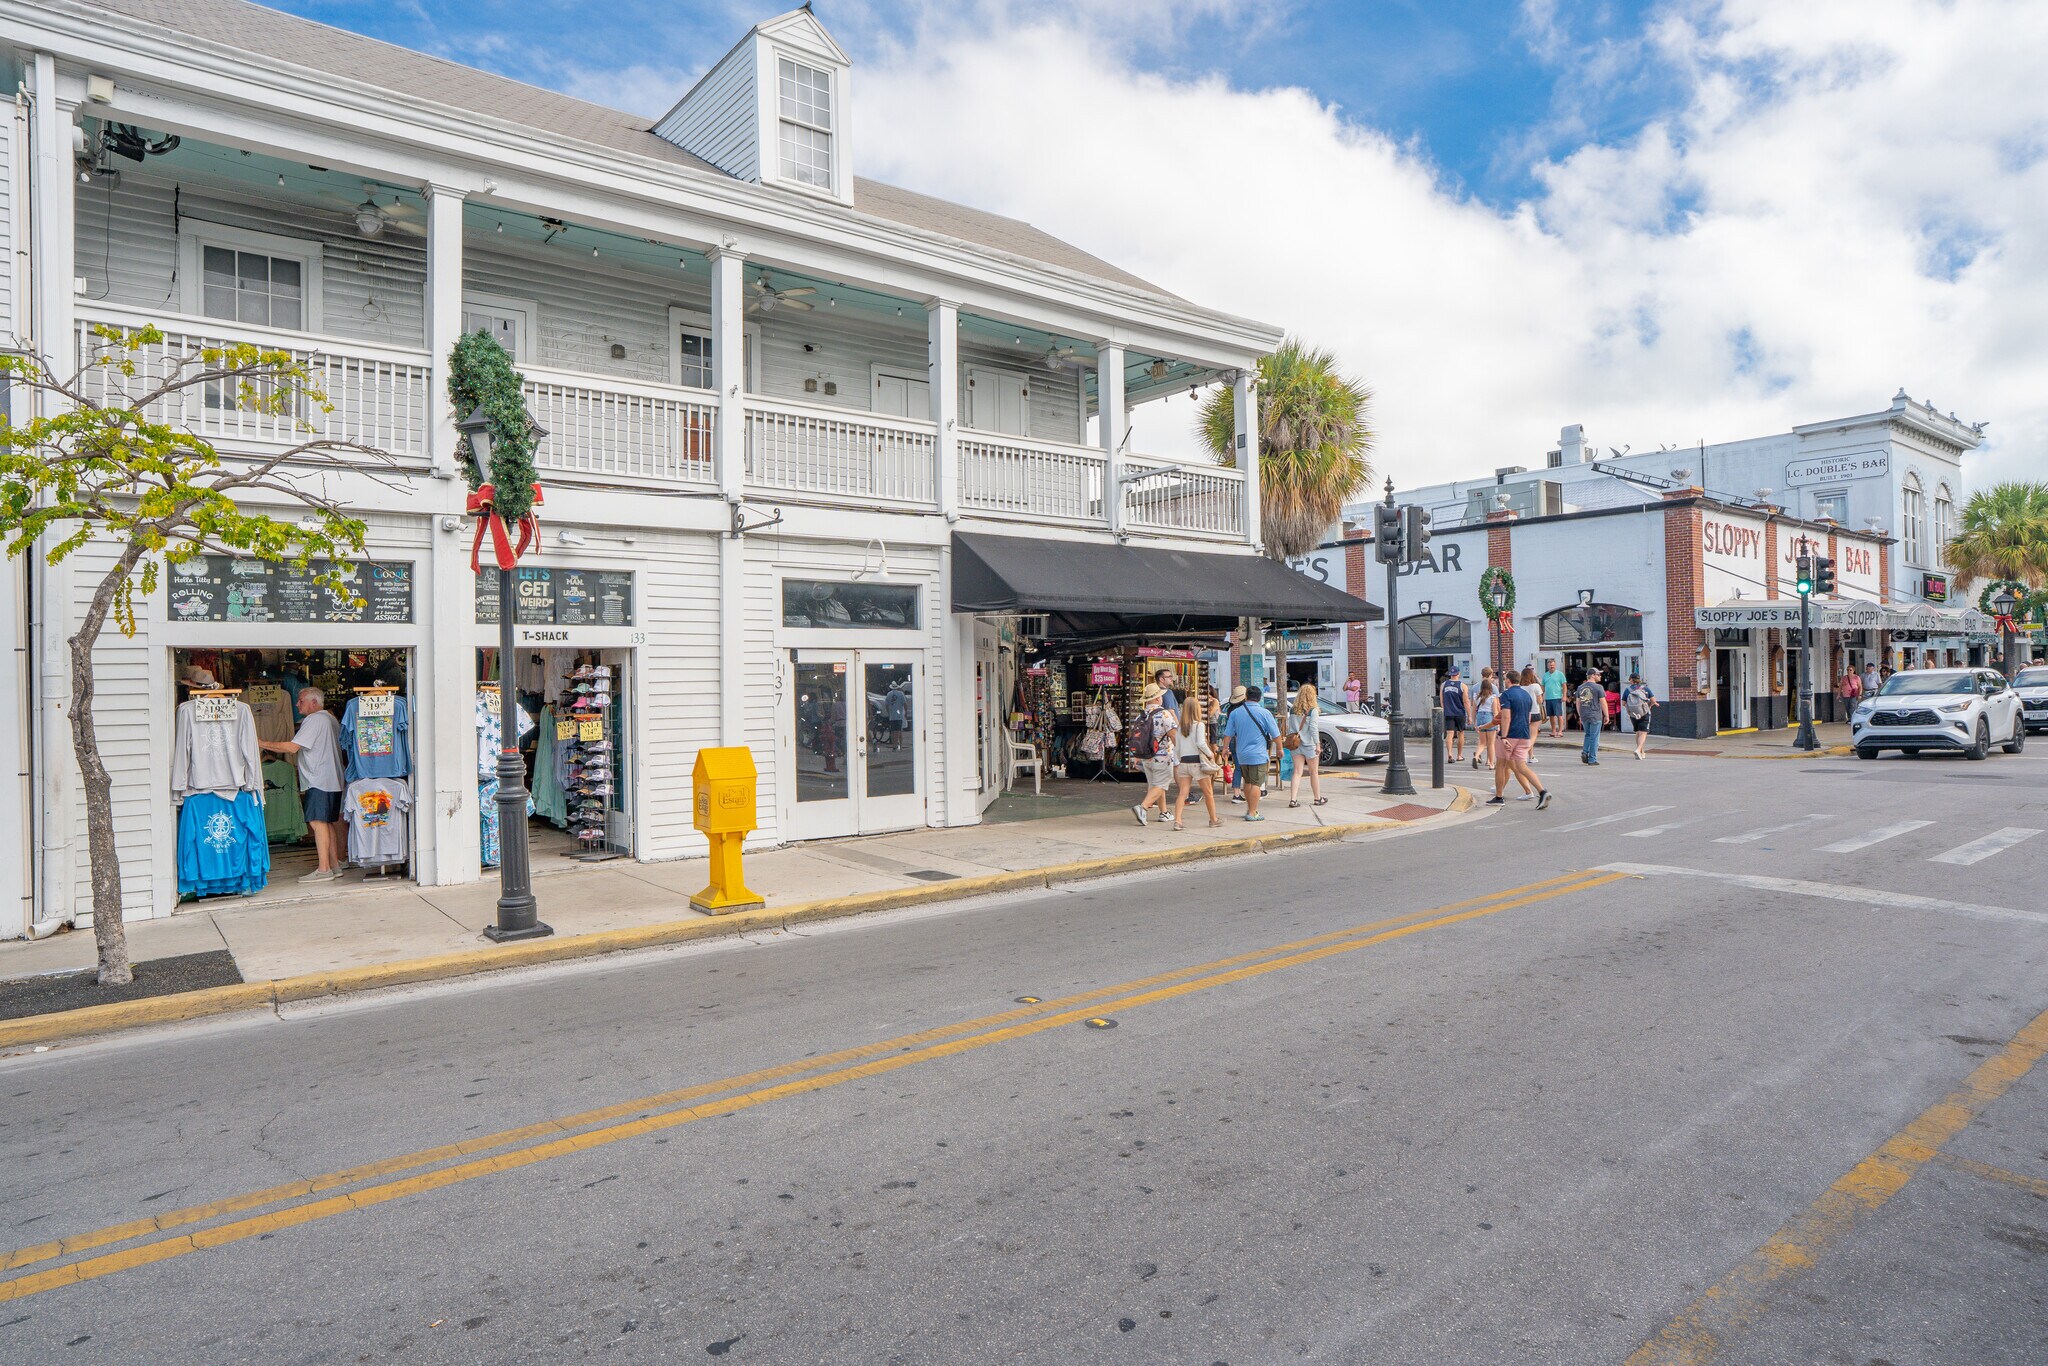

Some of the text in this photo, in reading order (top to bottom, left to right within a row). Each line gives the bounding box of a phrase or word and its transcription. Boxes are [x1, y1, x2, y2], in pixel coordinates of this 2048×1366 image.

[1821, 457, 1850, 465] HISTORIC
[1806, 463, 1857, 476] DOUBLE'S
[1862, 459, 1886, 469] BAR
[1704, 521, 1871, 575] SLOPPY JO'S BAR
[519, 568, 550, 580] LET'S
[172, 589, 214, 600] ROLLING
[519, 581, 550, 596] GET
[519, 597, 550, 607] WEIRD
[1701, 609, 1808, 622] SLOPPY JOE'S BA
[1848, 611, 1880, 625] SLOPPY
[1916, 615, 1936, 628] JOE'S
[1965, 619, 1976, 630] BAR
[522, 631, 569, 640] T-SHACK
[631, 633, 646, 644] 133
